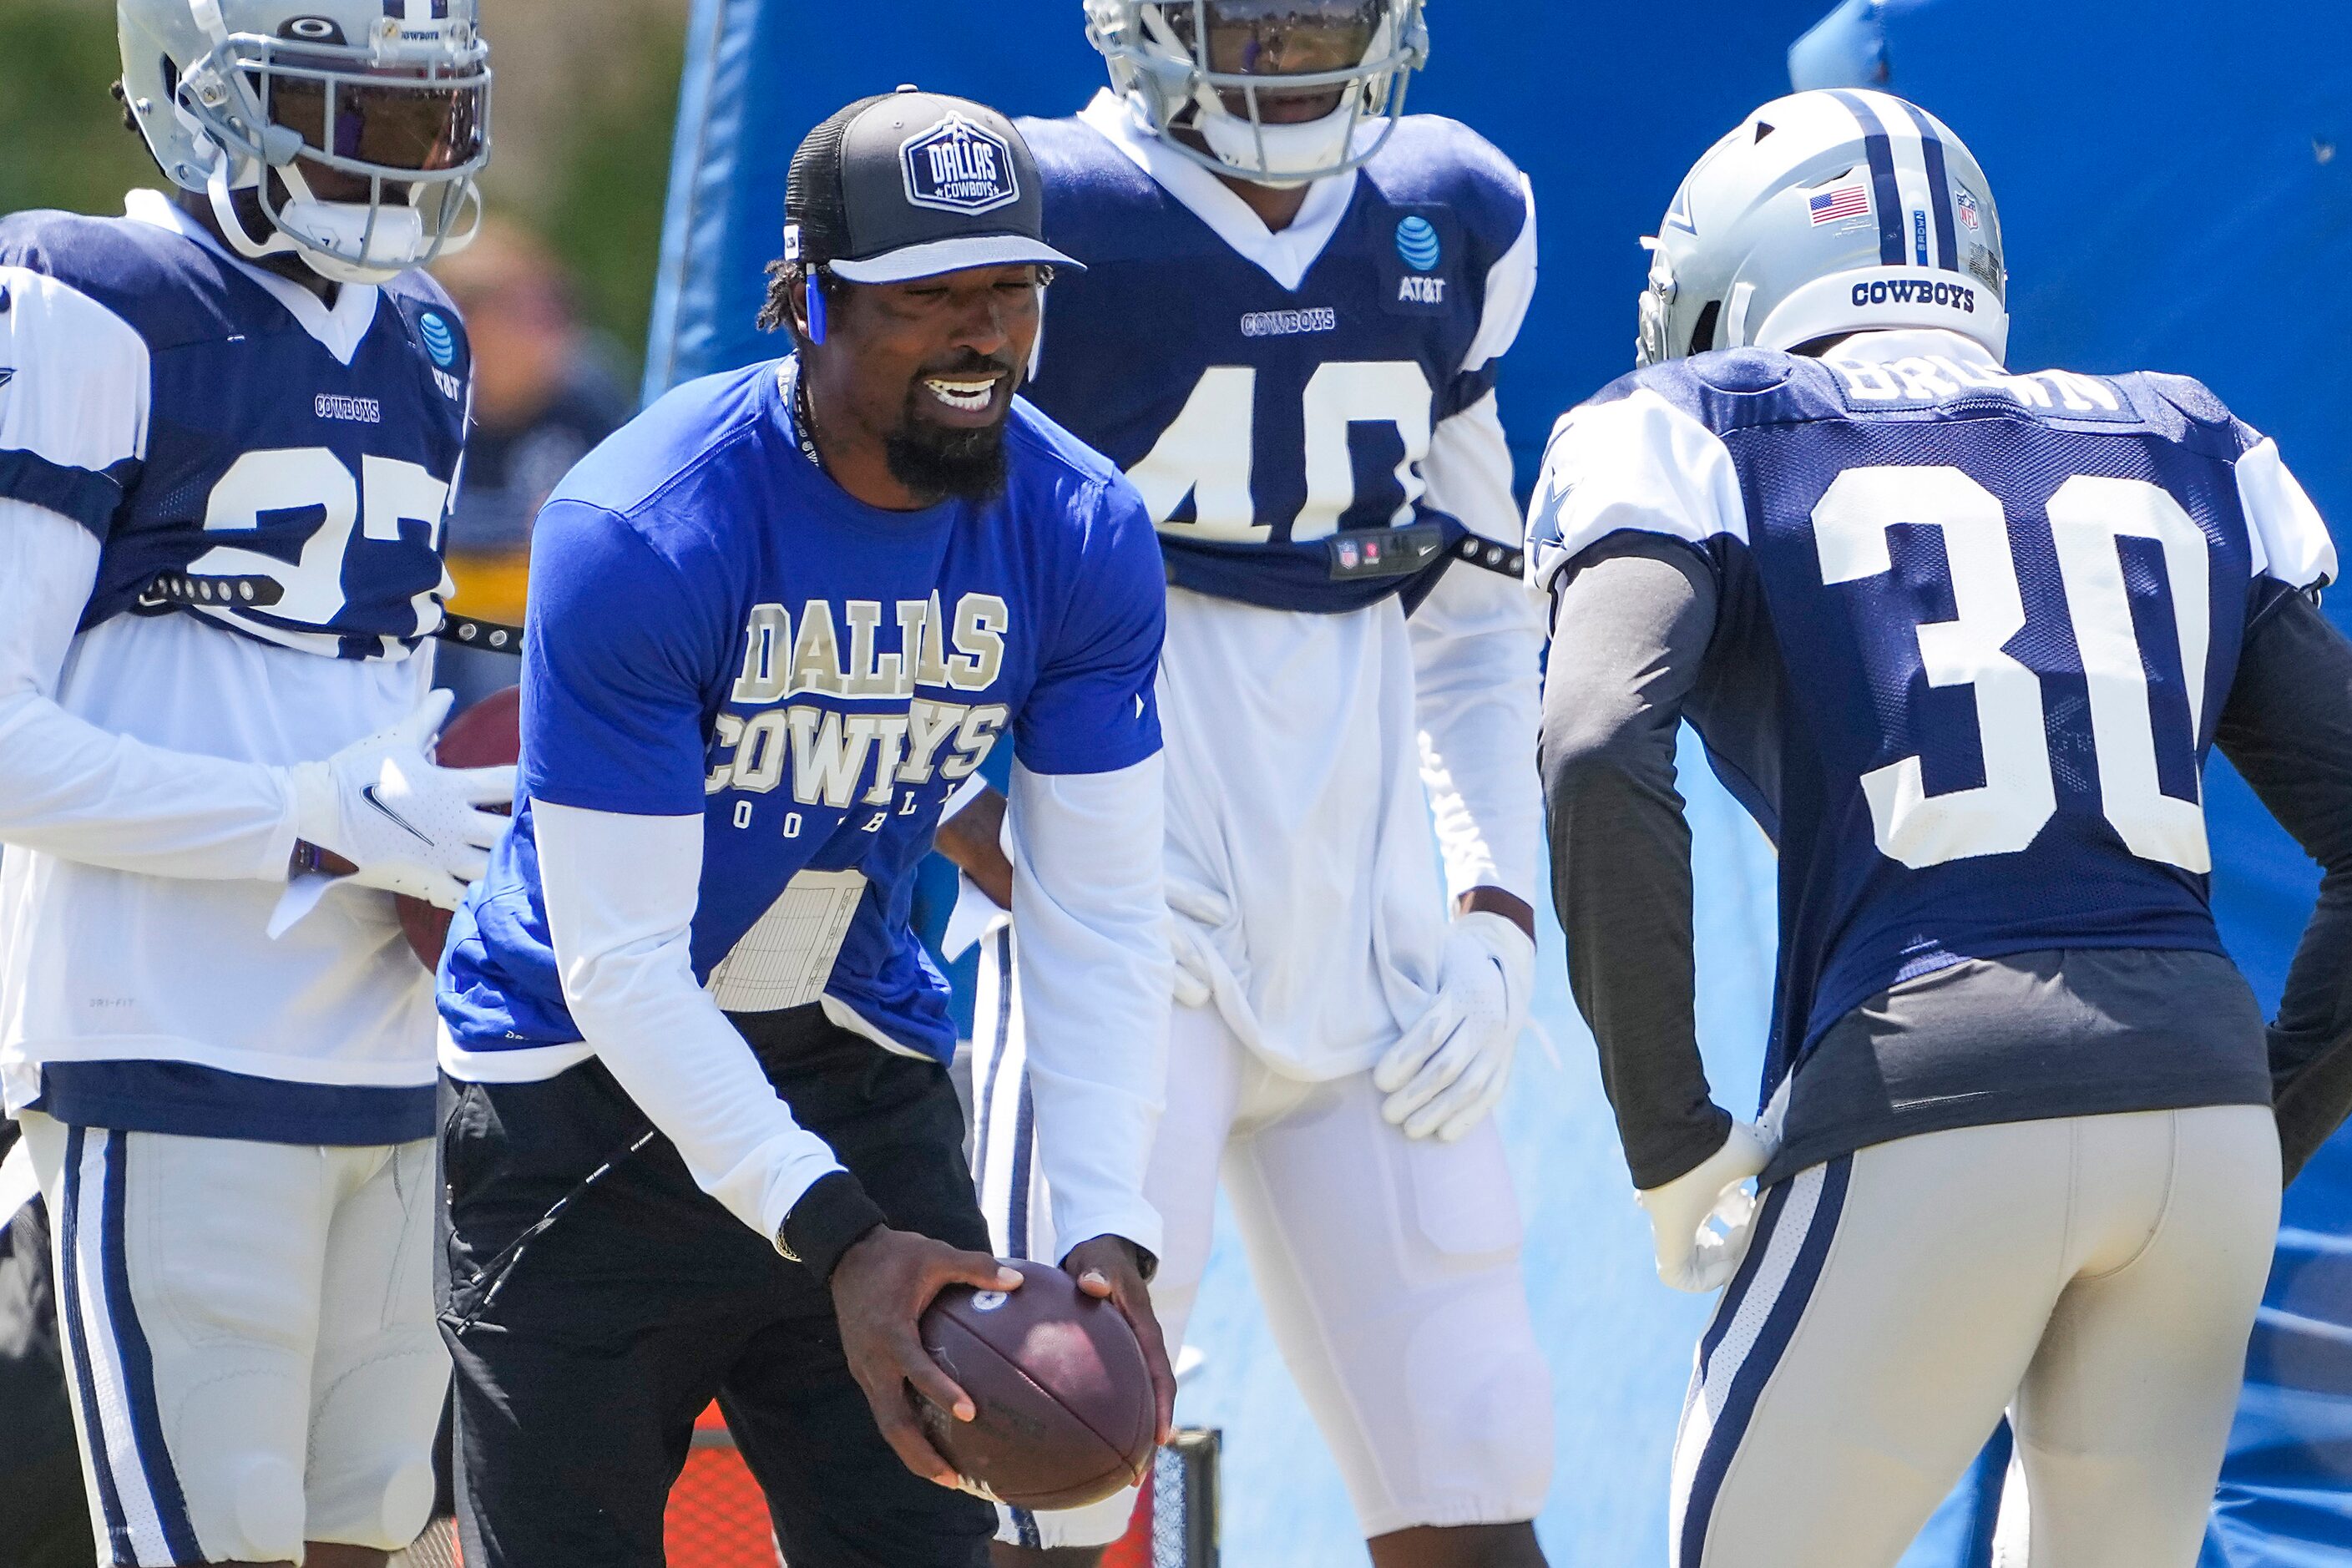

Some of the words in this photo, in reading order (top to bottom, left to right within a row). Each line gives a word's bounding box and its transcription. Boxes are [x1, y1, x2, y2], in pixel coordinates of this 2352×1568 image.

[926, 141, 997, 184] DALLAS
[943, 181, 994, 199] COWBOYS
[1915, 211, 1926, 251] BROWN
[1398, 276, 1446, 304] AT&T
[1852, 280, 1975, 314] COWBOYS
[1241, 306, 1335, 336] COWBOYS
[315, 393, 380, 423] COWBOYS
[1125, 361, 1434, 544] 40
[186, 446, 456, 643] 27
[1810, 465, 2212, 874] 30
